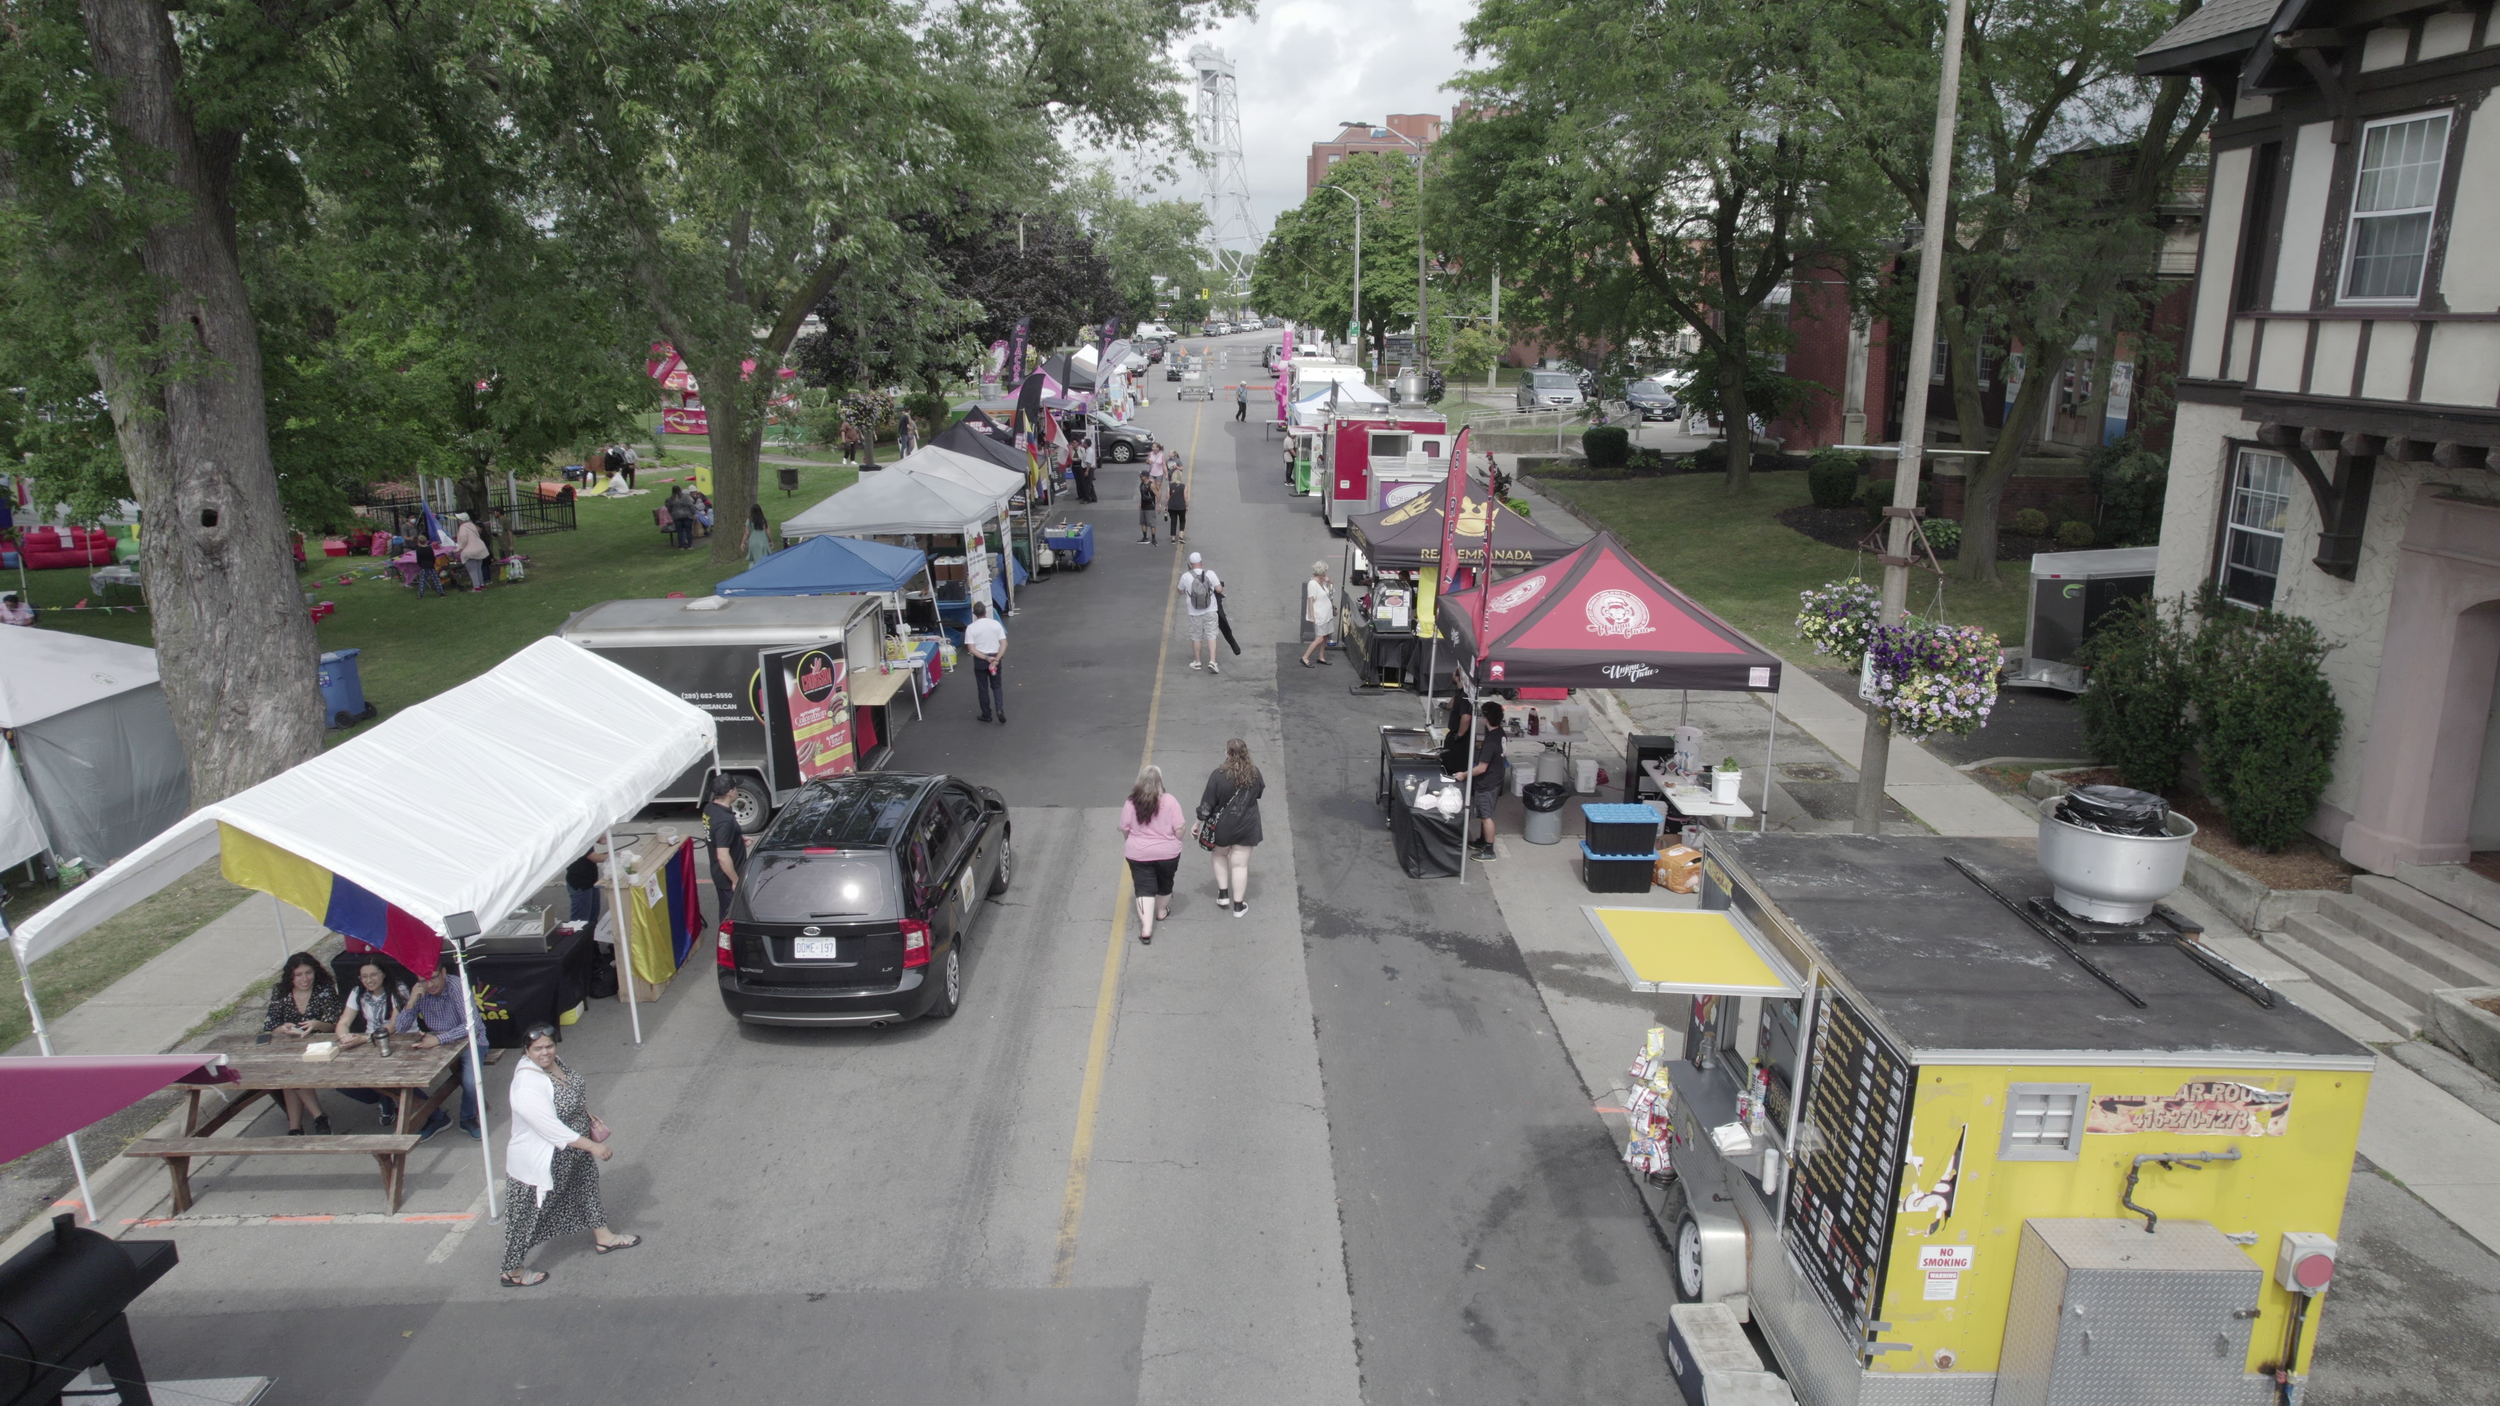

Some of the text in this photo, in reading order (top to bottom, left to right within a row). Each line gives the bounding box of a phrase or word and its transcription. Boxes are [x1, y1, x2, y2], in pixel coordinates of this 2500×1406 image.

[1012, 338, 1024, 382] TACOS
[820, 943, 833, 953] 197
[2133, 1109, 2250, 1129] 416-270-7273
[1940, 1248, 1954, 1256] NO
[1923, 1258, 1967, 1267] SMOKING
